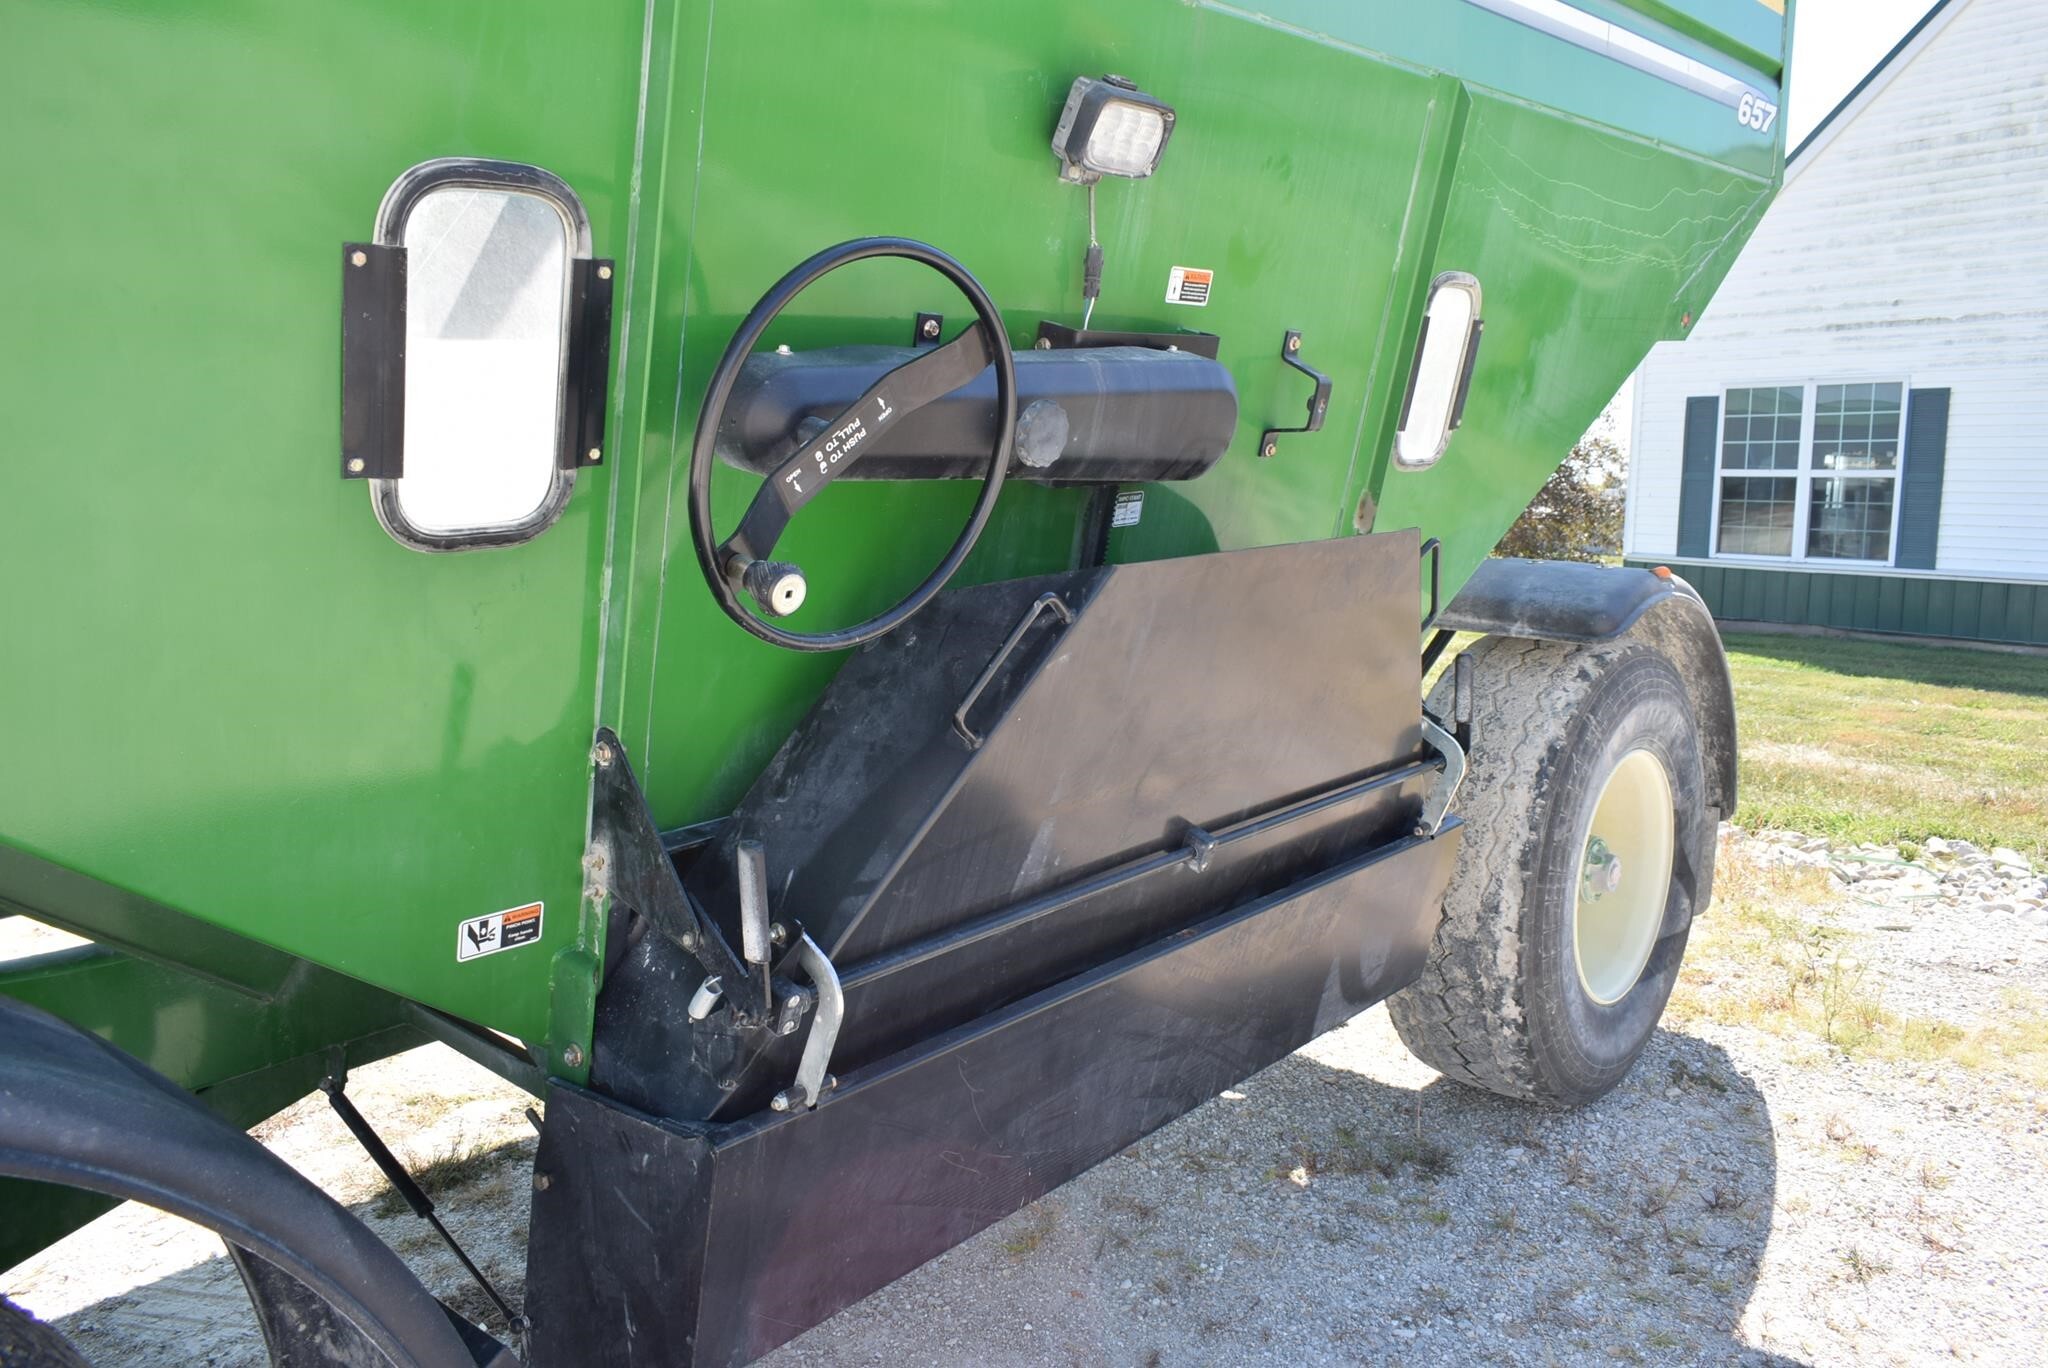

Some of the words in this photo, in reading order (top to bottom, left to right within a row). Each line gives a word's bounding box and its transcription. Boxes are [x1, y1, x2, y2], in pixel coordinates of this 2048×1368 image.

[1738, 91, 1778, 133] 657
[838, 417, 861, 439] PULL
[825, 438, 840, 452] TO
[842, 427, 867, 453] PUSH
[829, 449, 844, 463] TO
